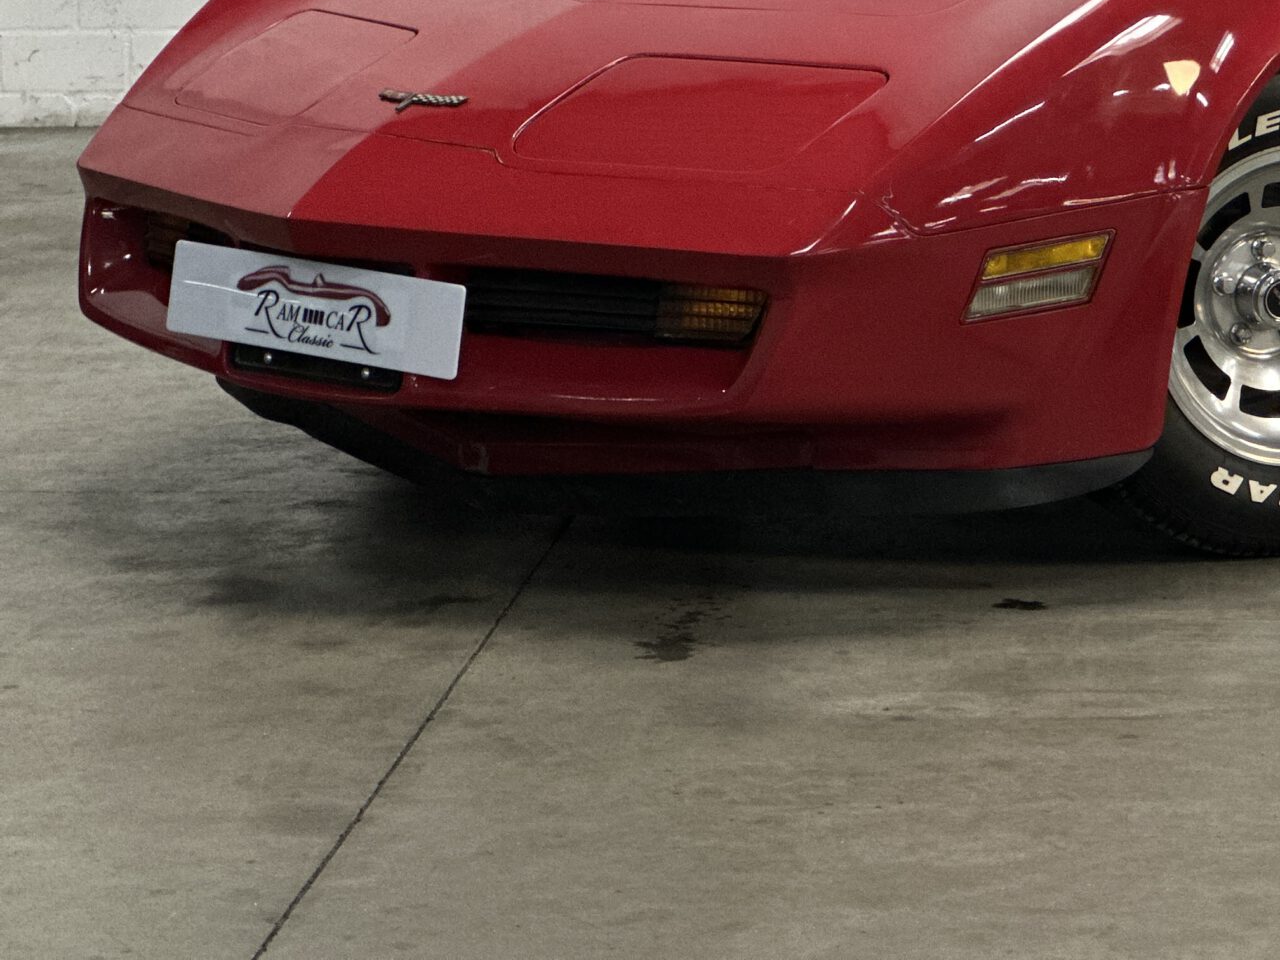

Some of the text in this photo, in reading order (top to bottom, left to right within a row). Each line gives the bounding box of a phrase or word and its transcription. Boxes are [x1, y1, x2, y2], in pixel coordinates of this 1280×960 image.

[254, 290, 381, 355] RAM CAR
[287, 323, 334, 349] Classic
